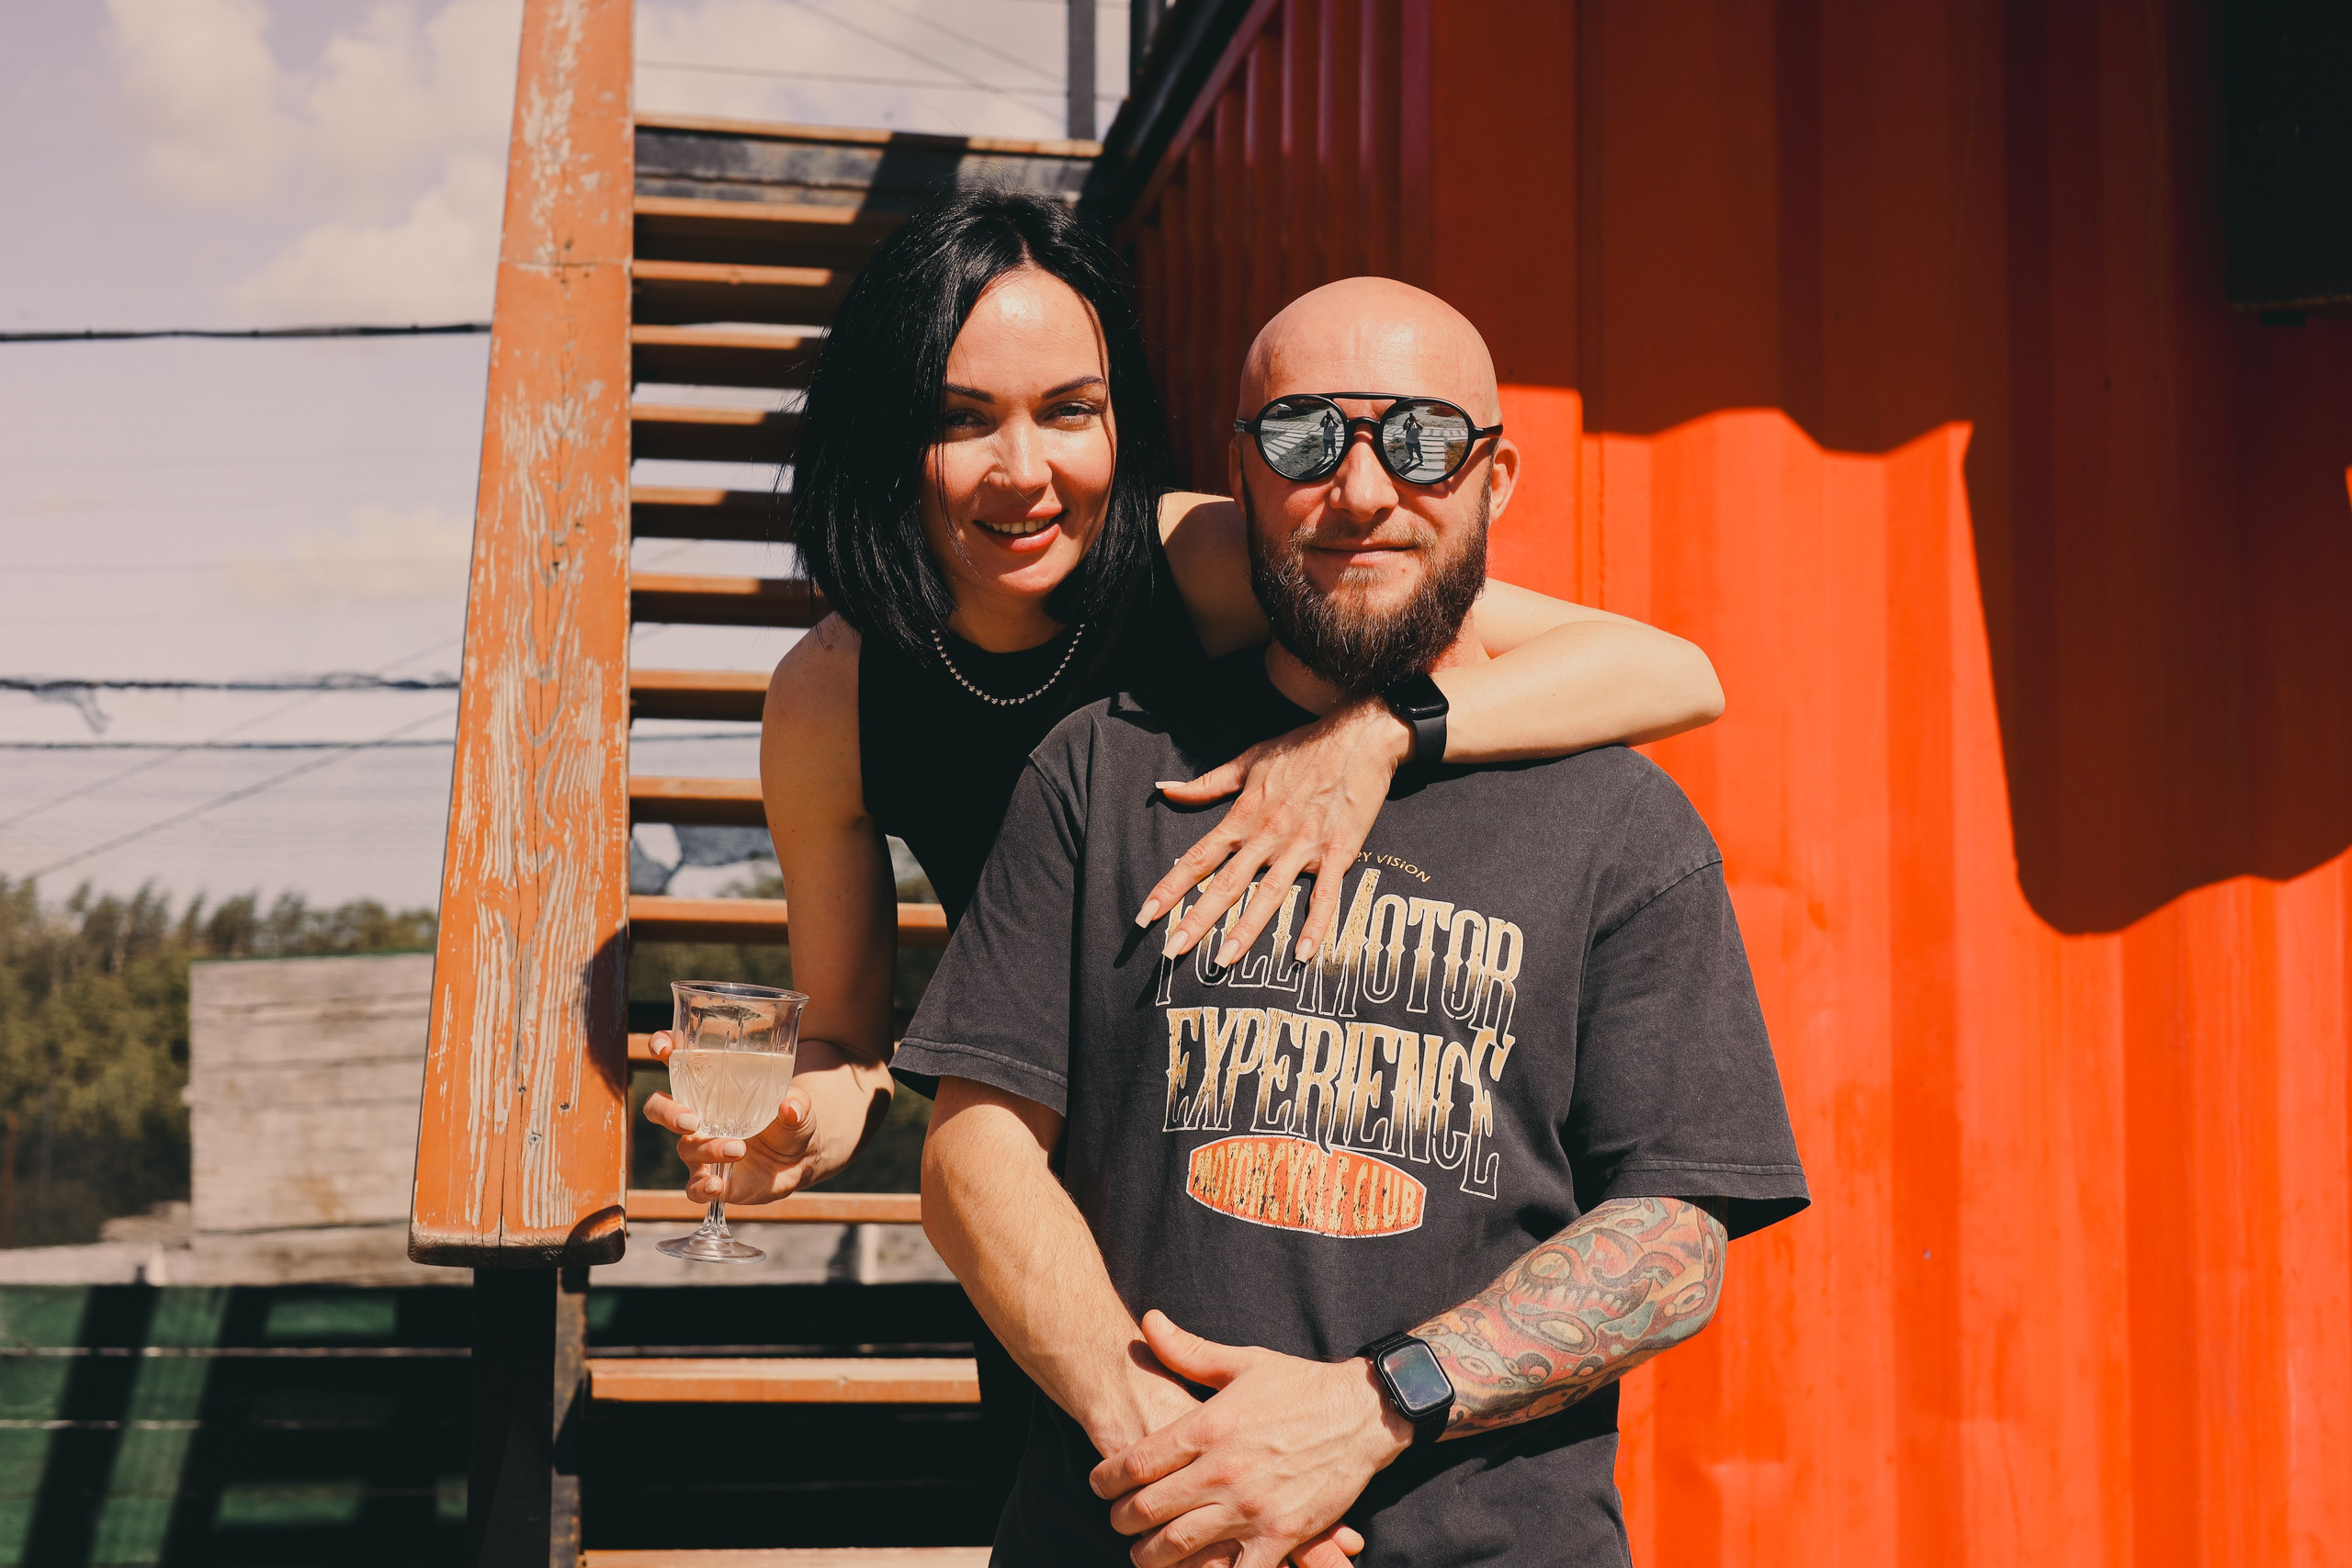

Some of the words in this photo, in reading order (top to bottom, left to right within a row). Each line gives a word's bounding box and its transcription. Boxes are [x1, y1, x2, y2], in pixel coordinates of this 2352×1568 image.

[1376, 853, 1431, 884] VISION
[1162, 1006, 1516, 1201] EXPERIENCE
[1193, 1141, 1351, 1232] MOTORCYCLE
[1352, 1162, 1418, 1232] CLUB
